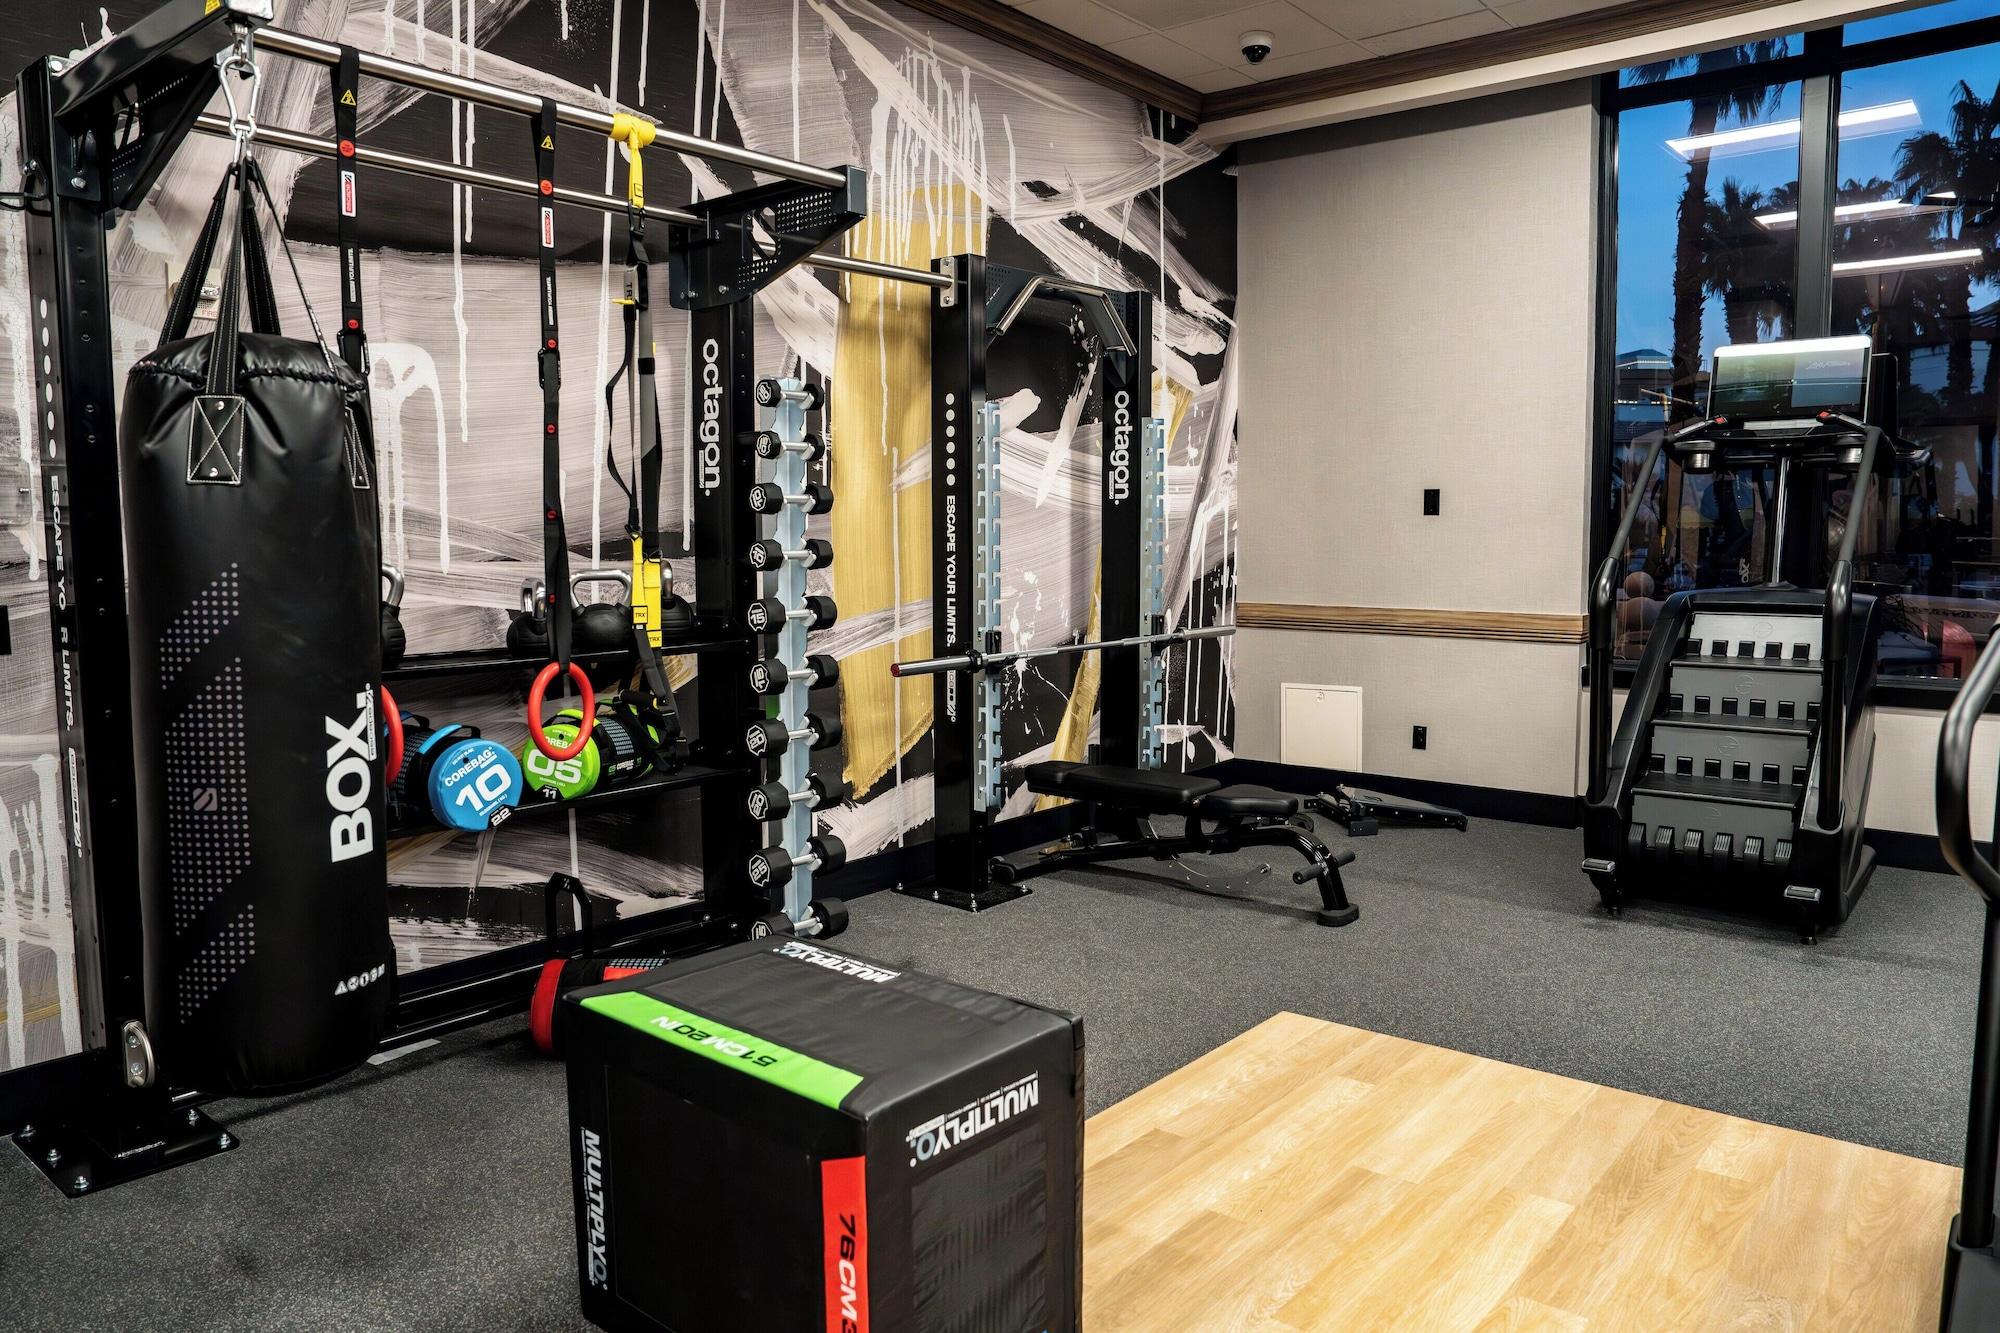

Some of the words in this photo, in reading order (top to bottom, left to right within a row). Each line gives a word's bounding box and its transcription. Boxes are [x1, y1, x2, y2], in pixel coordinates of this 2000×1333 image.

[51, 475, 64, 571] ESCAPE
[946, 495, 956, 552] ESCAPE
[946, 555, 956, 595] YOUR
[57, 575, 69, 644] YOR
[946, 598, 957, 648] LIMITS.
[61, 650, 75, 732] LIMITS.
[456, 764, 512, 812] 10
[527, 748, 583, 784] 05
[490, 807, 512, 827] 22
[542, 788, 557, 799] 11
